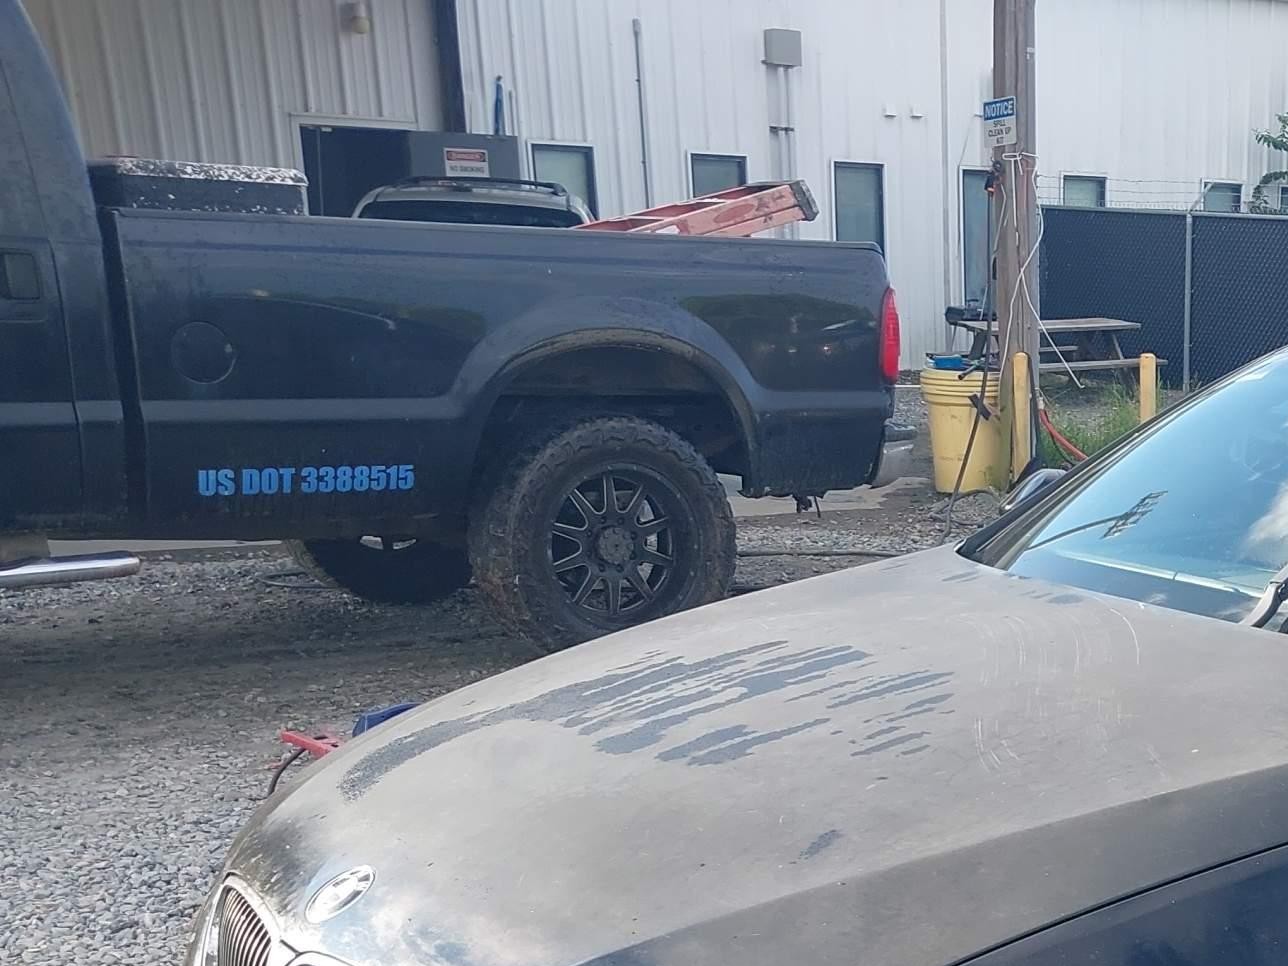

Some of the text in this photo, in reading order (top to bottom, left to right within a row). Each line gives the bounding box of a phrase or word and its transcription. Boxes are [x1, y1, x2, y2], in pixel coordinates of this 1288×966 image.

[985, 101, 1013, 118] NOTICE
[198, 465, 415, 496] US DOT 3388515
